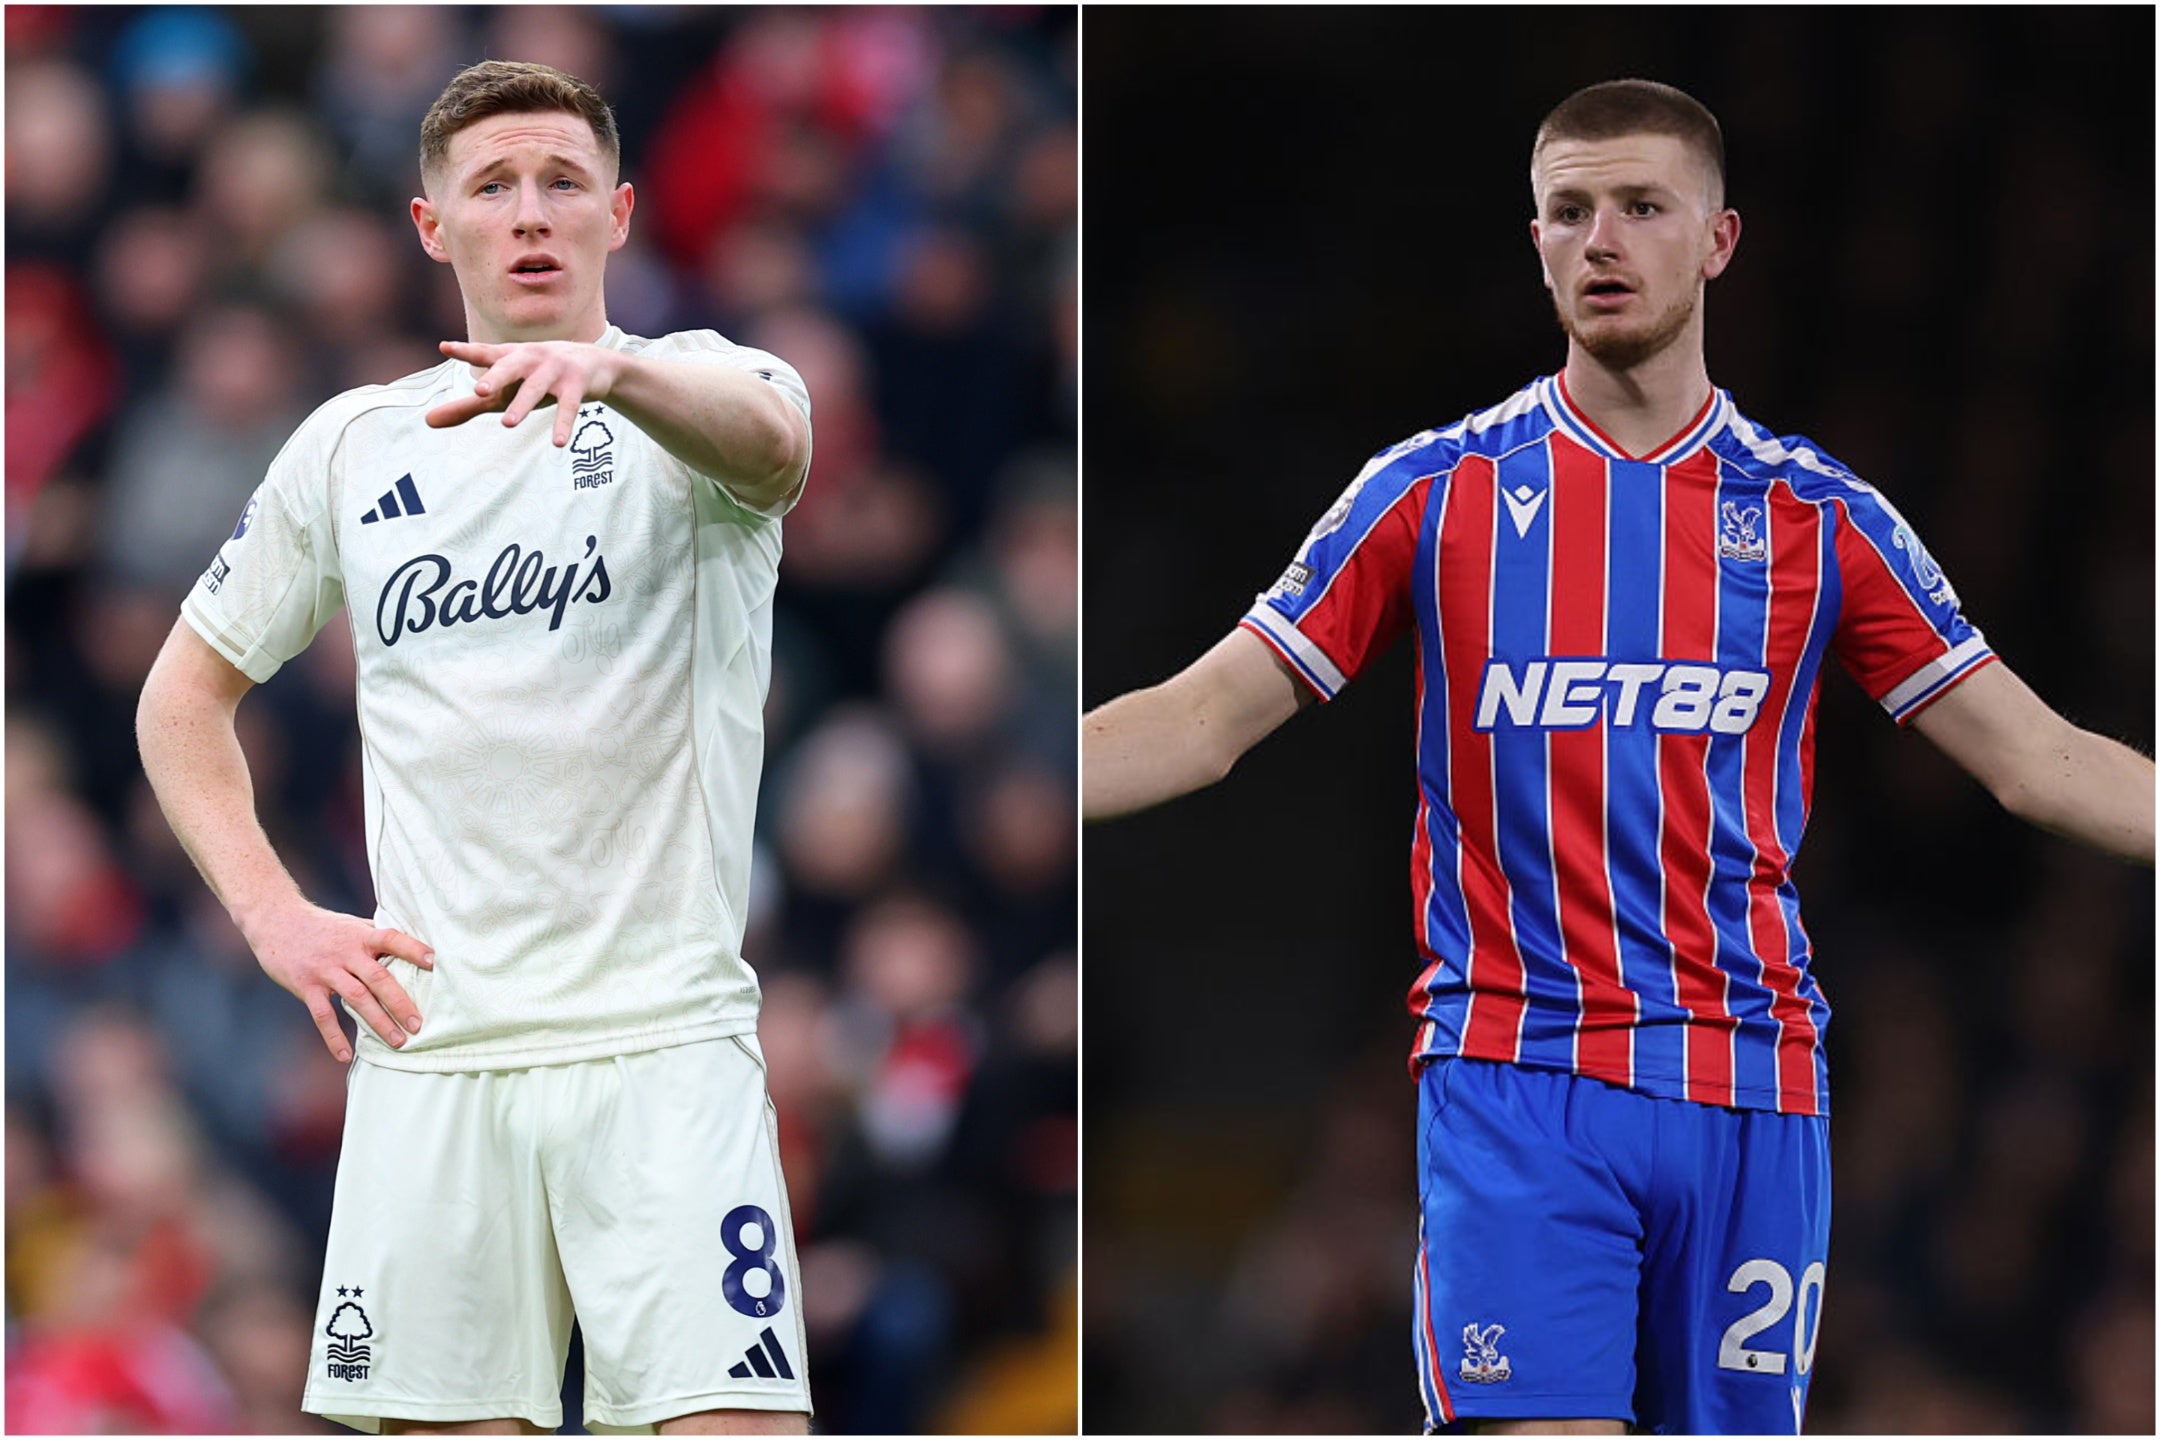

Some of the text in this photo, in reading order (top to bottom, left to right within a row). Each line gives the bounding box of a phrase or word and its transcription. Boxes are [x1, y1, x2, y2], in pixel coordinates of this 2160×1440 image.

[376, 535, 611, 647] Bally's
[1476, 661, 1770, 735] NET88
[720, 1204, 785, 1318] 8
[1718, 1258, 1826, 1376] 20
